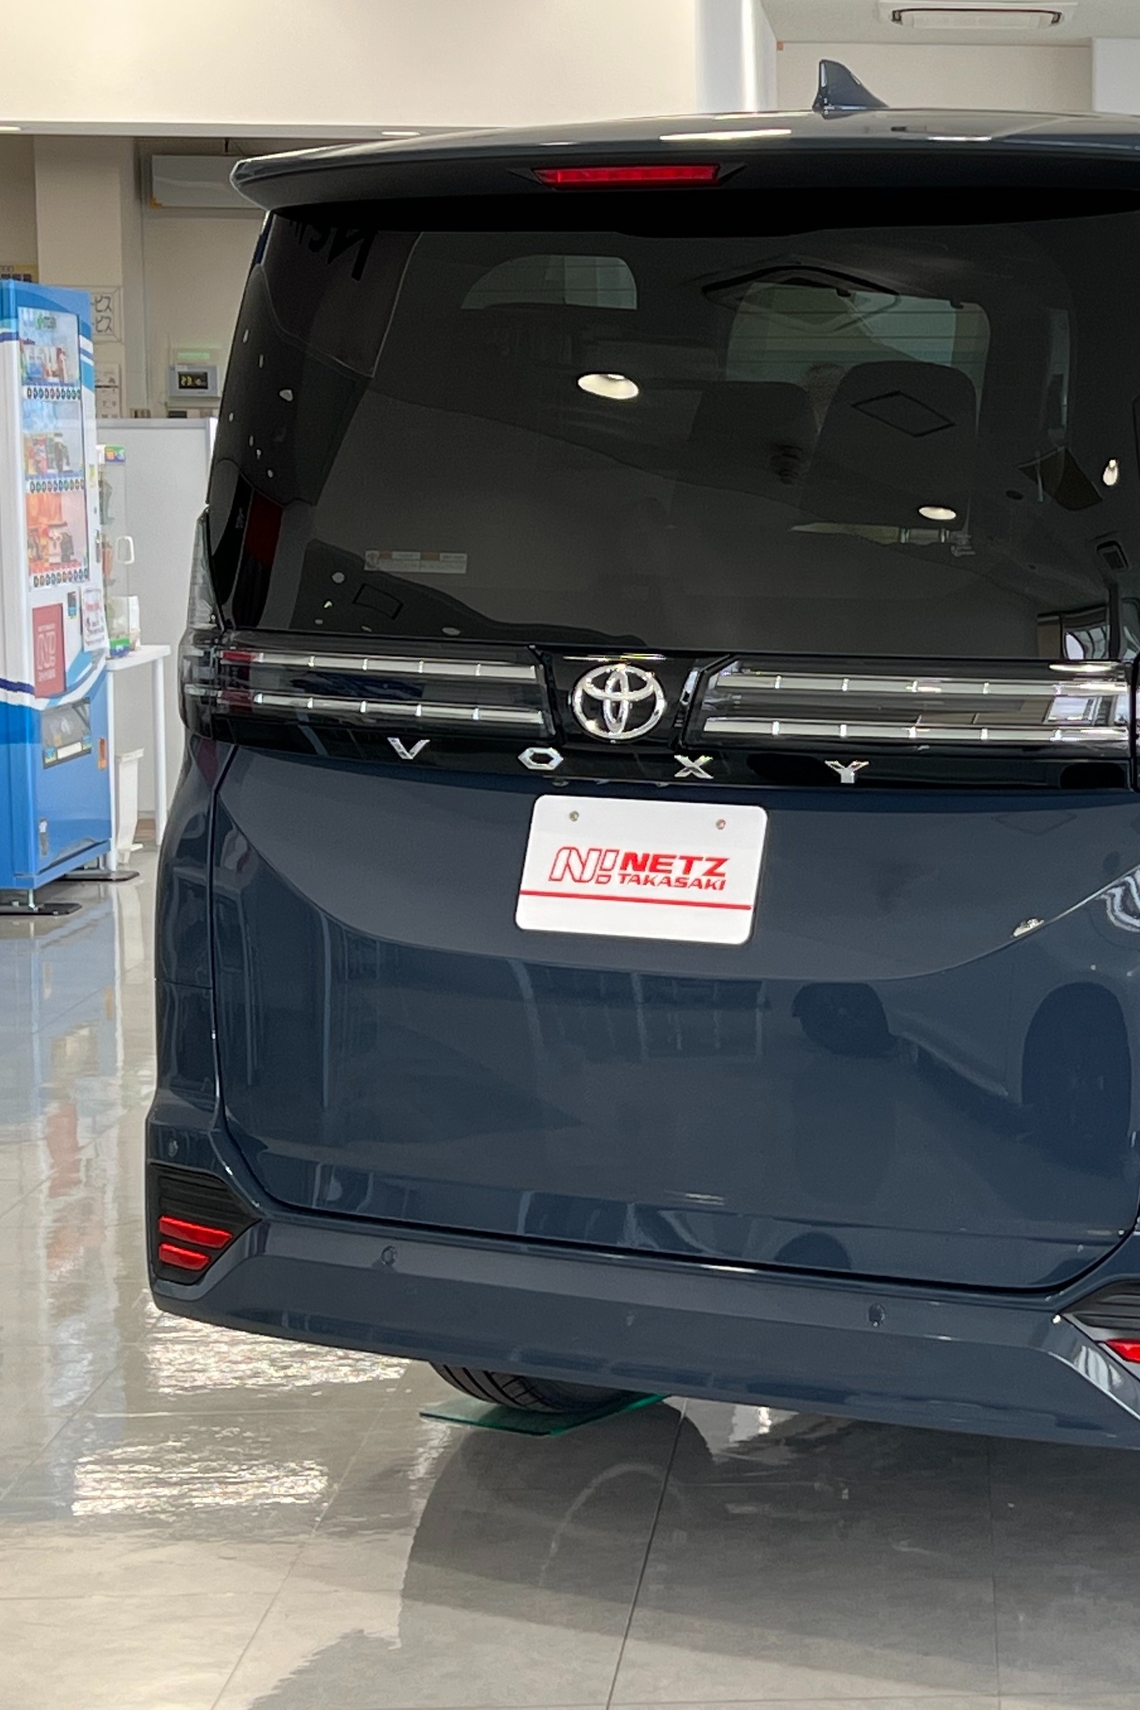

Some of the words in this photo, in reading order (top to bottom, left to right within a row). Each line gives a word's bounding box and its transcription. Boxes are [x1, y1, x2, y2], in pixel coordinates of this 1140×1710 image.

[387, 737, 870, 784] VOXY
[620, 852, 730, 878] NETZ
[618, 873, 727, 891] TAKASAKI
